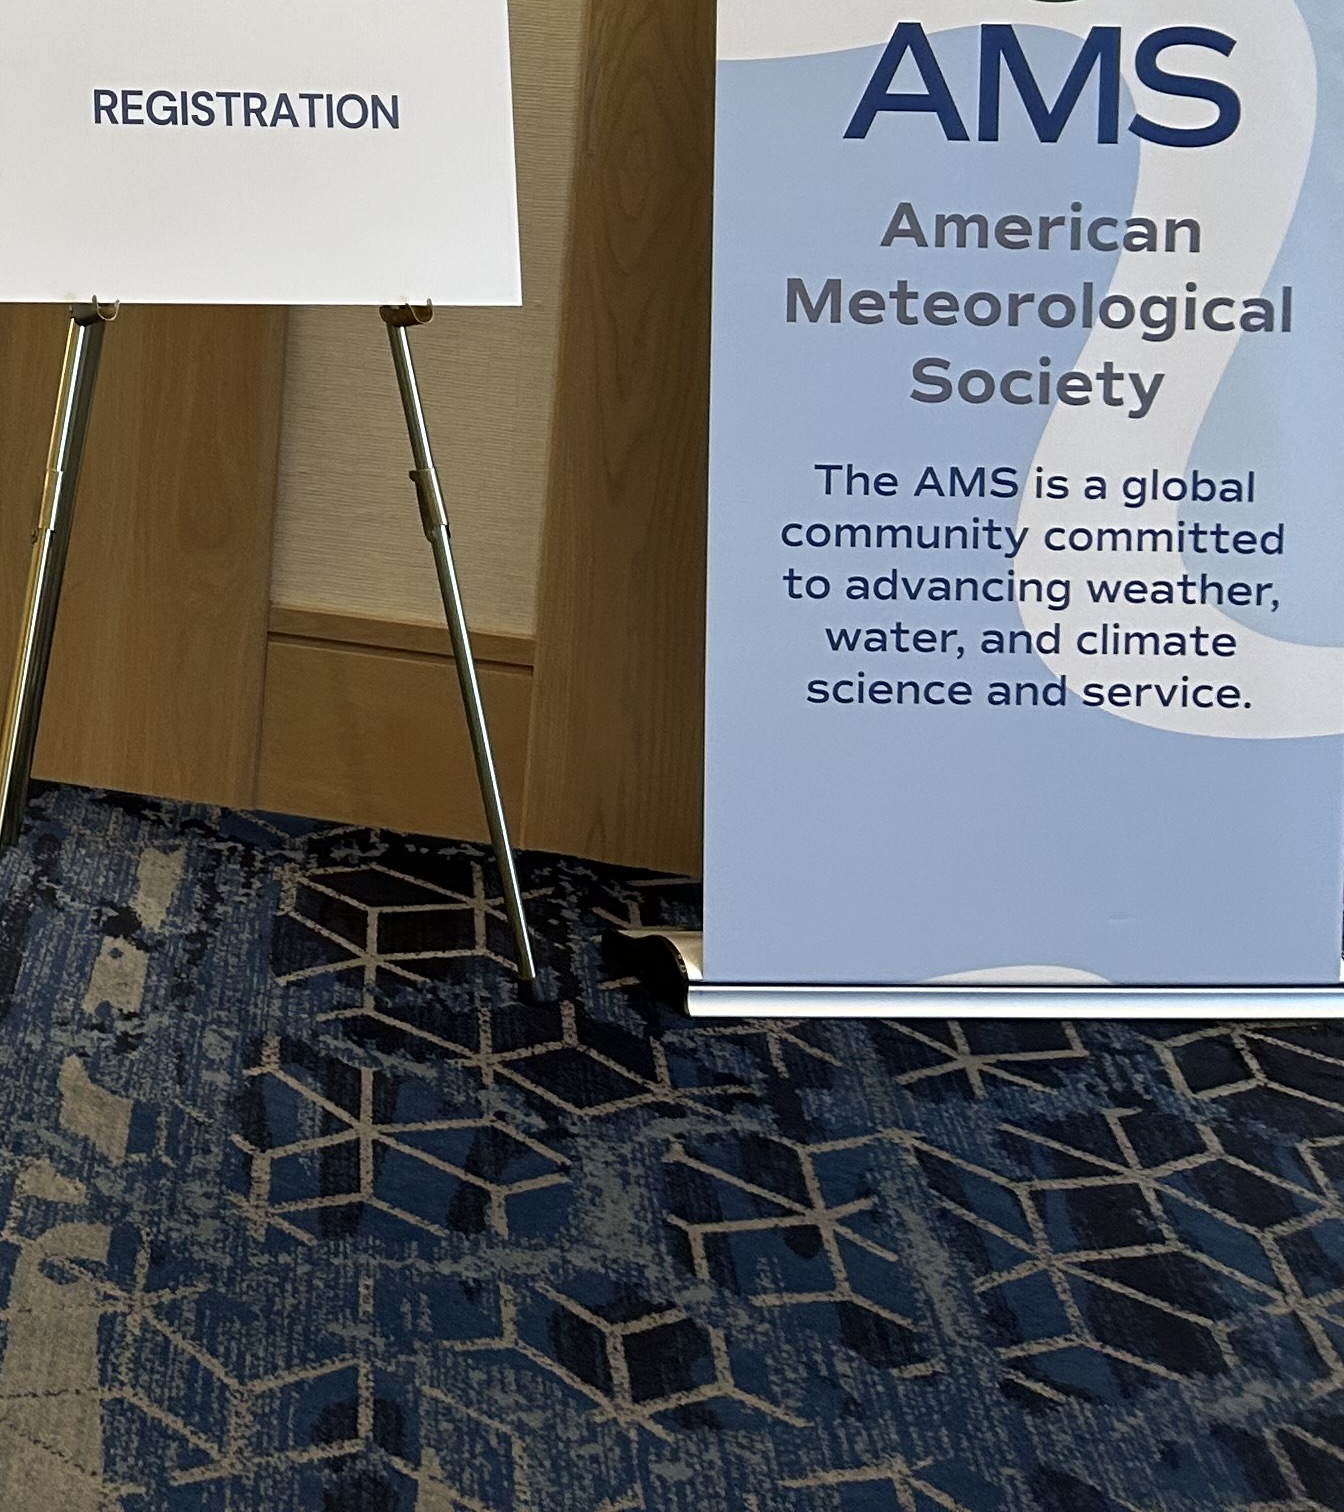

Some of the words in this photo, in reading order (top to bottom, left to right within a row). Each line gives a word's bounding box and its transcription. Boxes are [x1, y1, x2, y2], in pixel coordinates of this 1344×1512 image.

[843, 22, 1242, 148] AMS
[93, 89, 400, 130] REGISTRATION
[879, 201, 1201, 253] American
[786, 277, 1293, 343] Meteorological
[910, 356, 1165, 419] Society
[814, 463, 898, 497] The
[914, 466, 1019, 498] AMS
[1034, 466, 1069, 500] is
[1083, 475, 1107, 500] a
[1122, 468, 1255, 508] global
[781, 517, 1029, 559] community
[1044, 519, 1285, 555] committed
[783, 568, 831, 600] to
[845, 568, 1071, 611] advancing
[1087, 574, 1281, 613] weather,
[825, 621, 965, 659] water,
[980, 623, 1061, 655] and
[1076, 623, 1237, 658] climate
[806, 671, 972, 706] science
[986, 675, 1067, 706] and
[1082, 676, 1252, 710] service.
